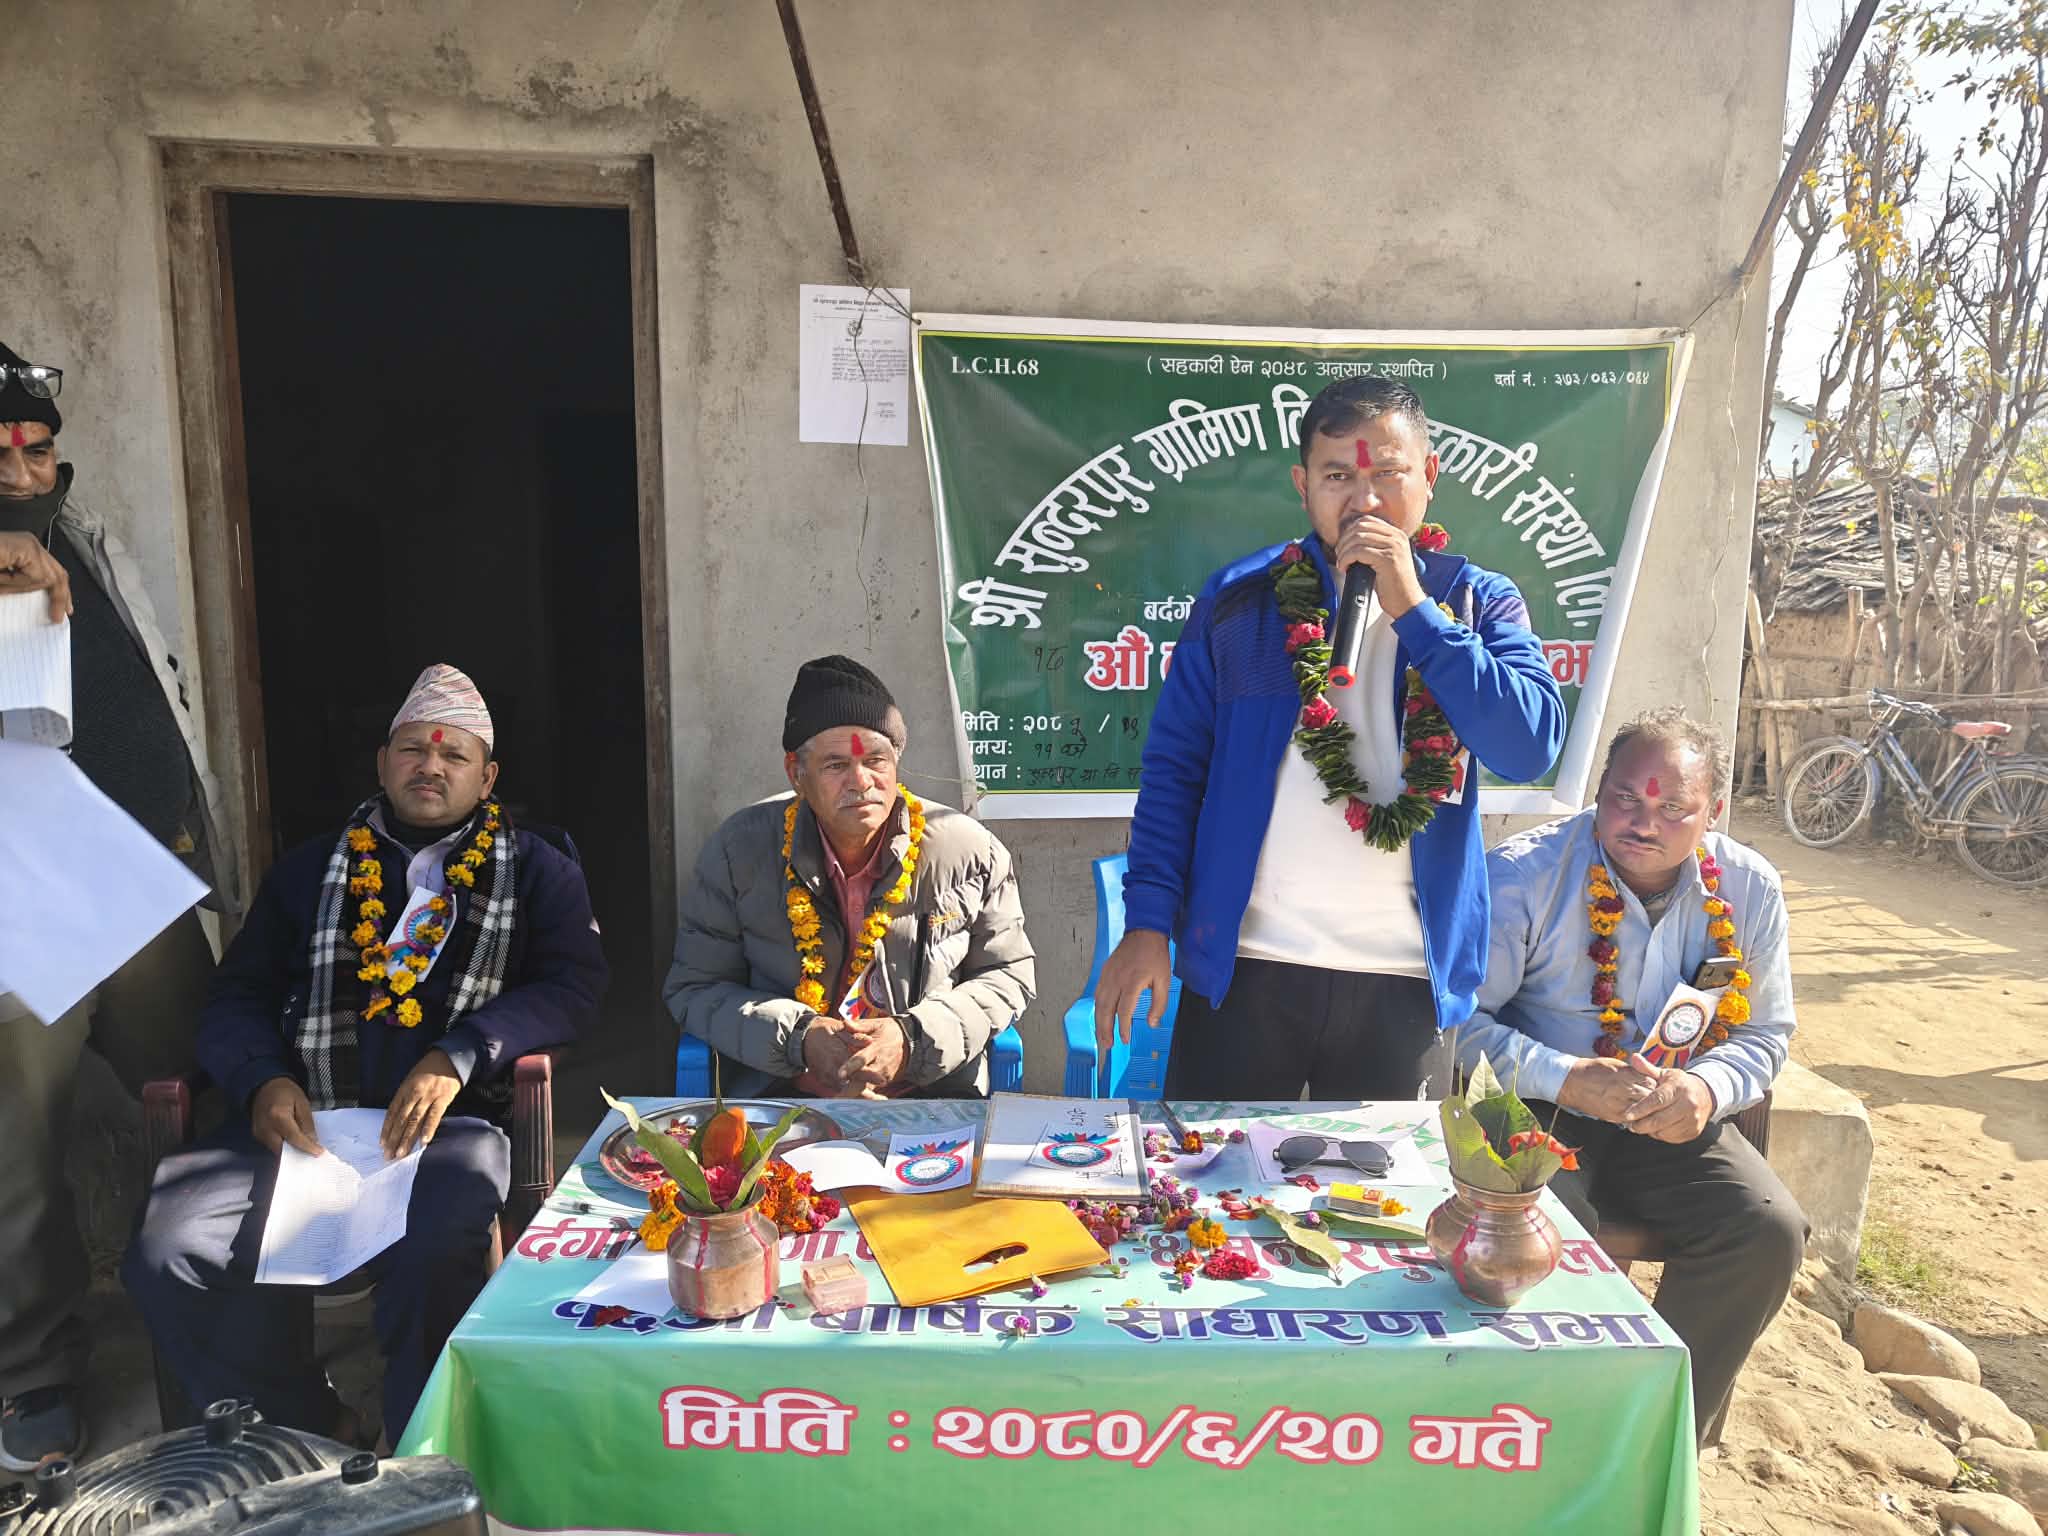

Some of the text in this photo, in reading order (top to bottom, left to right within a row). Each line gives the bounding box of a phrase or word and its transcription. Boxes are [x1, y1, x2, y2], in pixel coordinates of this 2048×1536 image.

[951, 356, 1040, 375] L.C.H.68
[1160, 354, 1224, 376] सहकारी
[1230, 356, 1254, 375] ऐन
[1379, 359, 1435, 378] स्थापित
[1131, 398, 1267, 483] ग्रामिण
[994, 444, 1155, 574] सुन्दरपुर
[1502, 472, 1607, 570] संस्था
[958, 576, 1048, 629] श्री
[1103, 1306, 1448, 1344] साधारण
[1469, 1311, 1668, 1350] सभा
[662, 1384, 859, 1458] मिति
[933, 1404, 1385, 1470] २०८०/६/२०
[1408, 1403, 1552, 1473] गते
